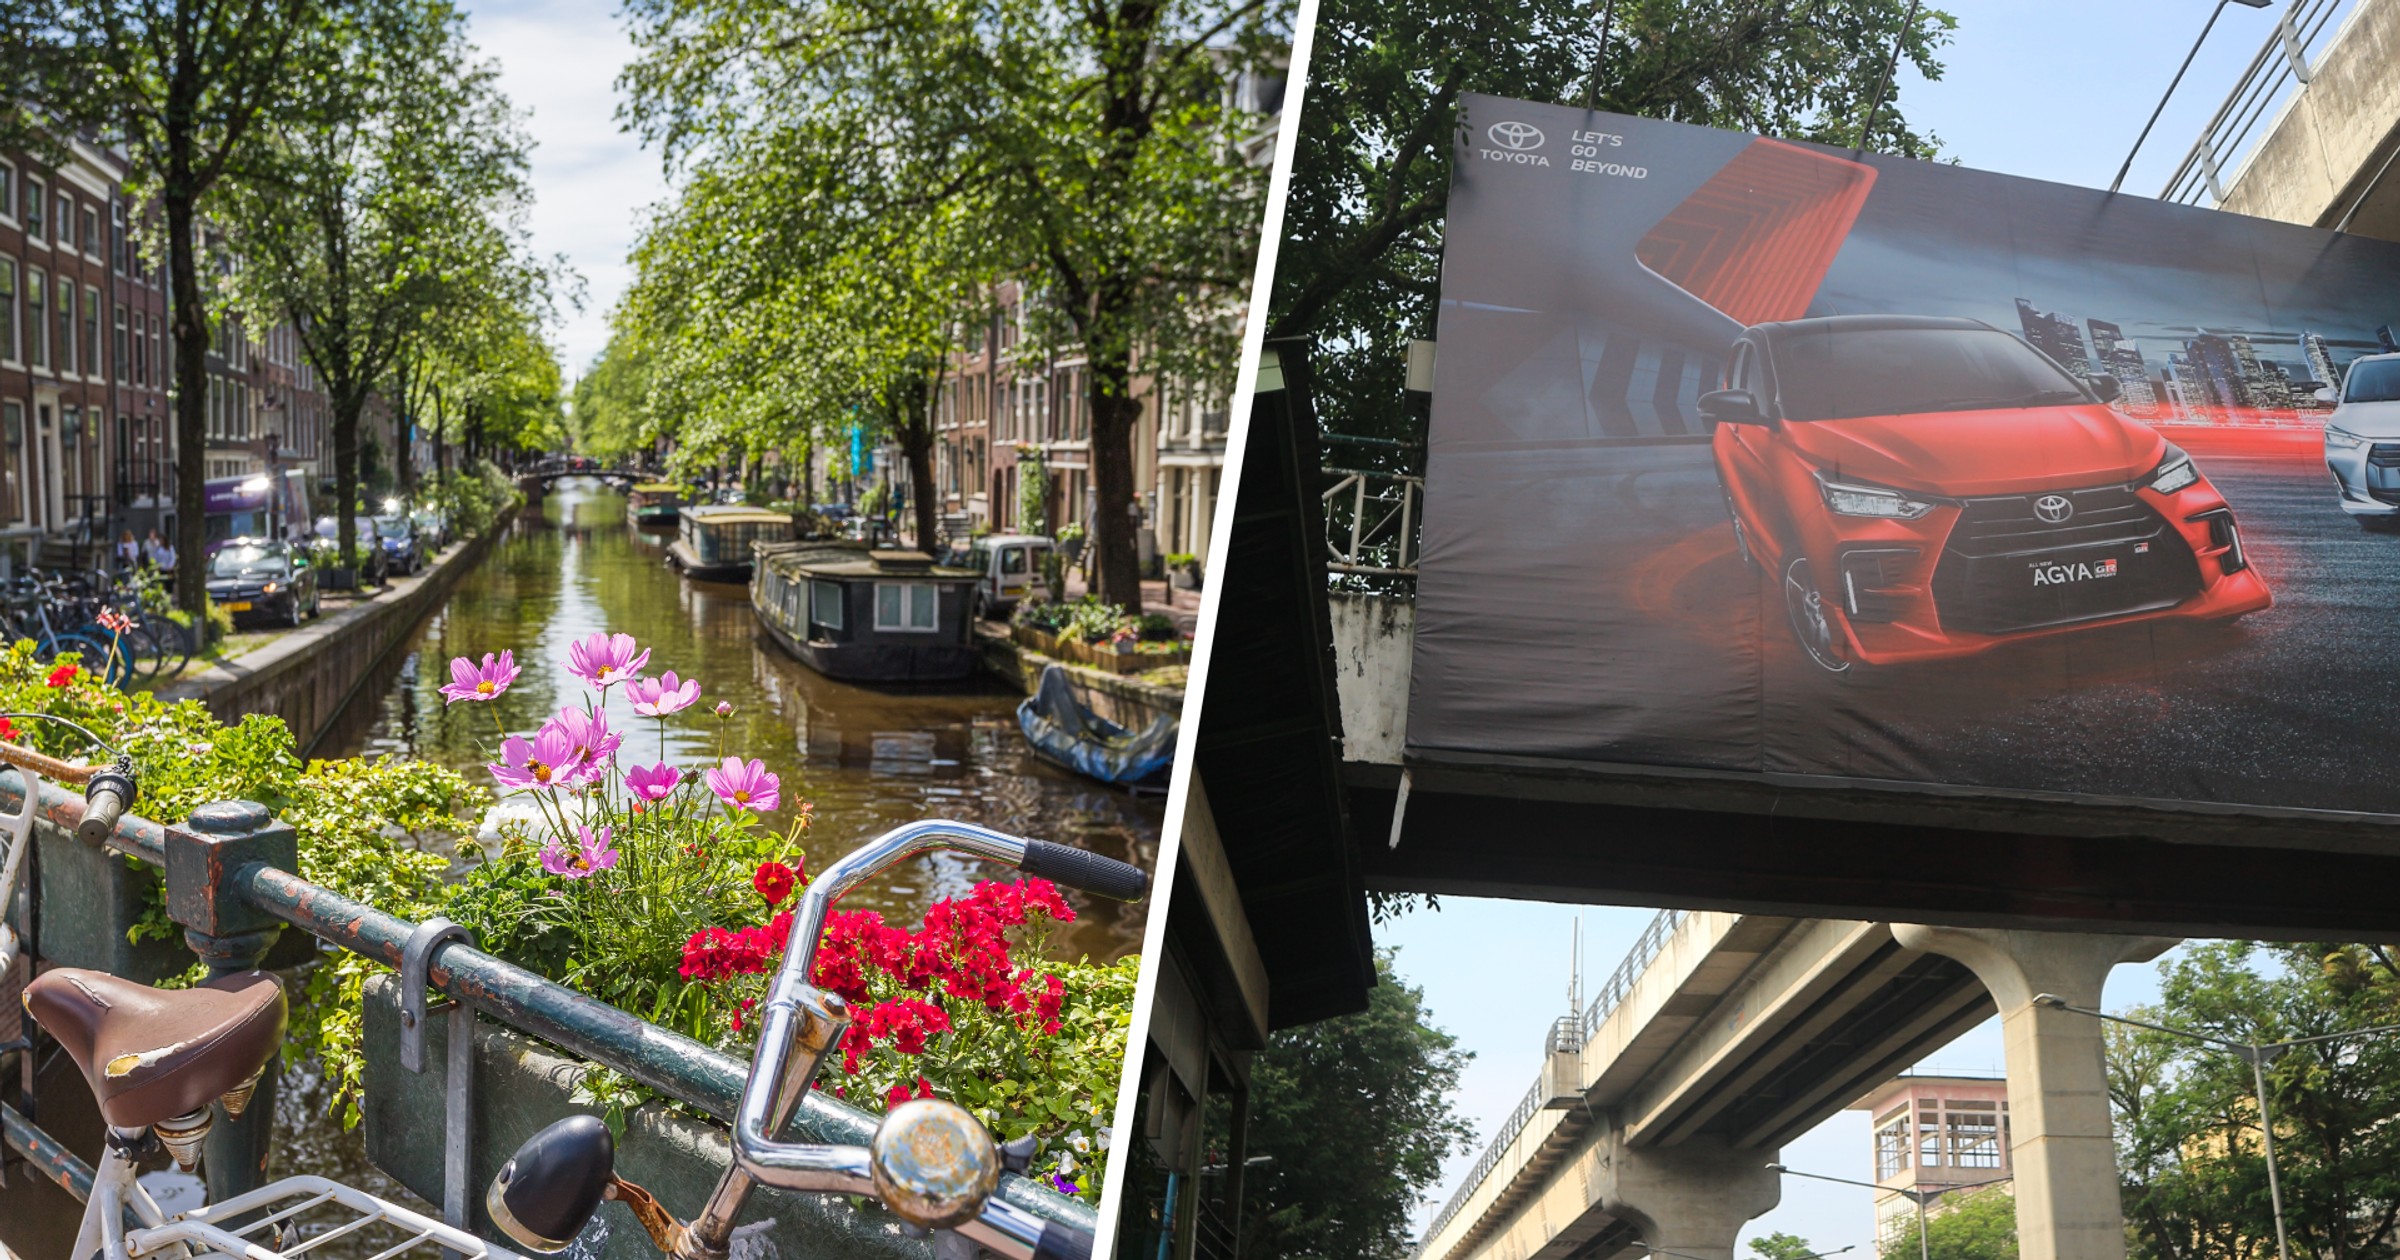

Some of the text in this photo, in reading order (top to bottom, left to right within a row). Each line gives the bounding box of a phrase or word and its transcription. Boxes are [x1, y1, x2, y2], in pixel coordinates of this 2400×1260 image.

[1571, 130, 1623, 147] LET'S
[1479, 149, 1550, 167] TOYOTA
[1571, 145, 1597, 158] GO
[1570, 160, 1648, 179] BEYOND
[2033, 562, 2117, 586] AGYA GR
